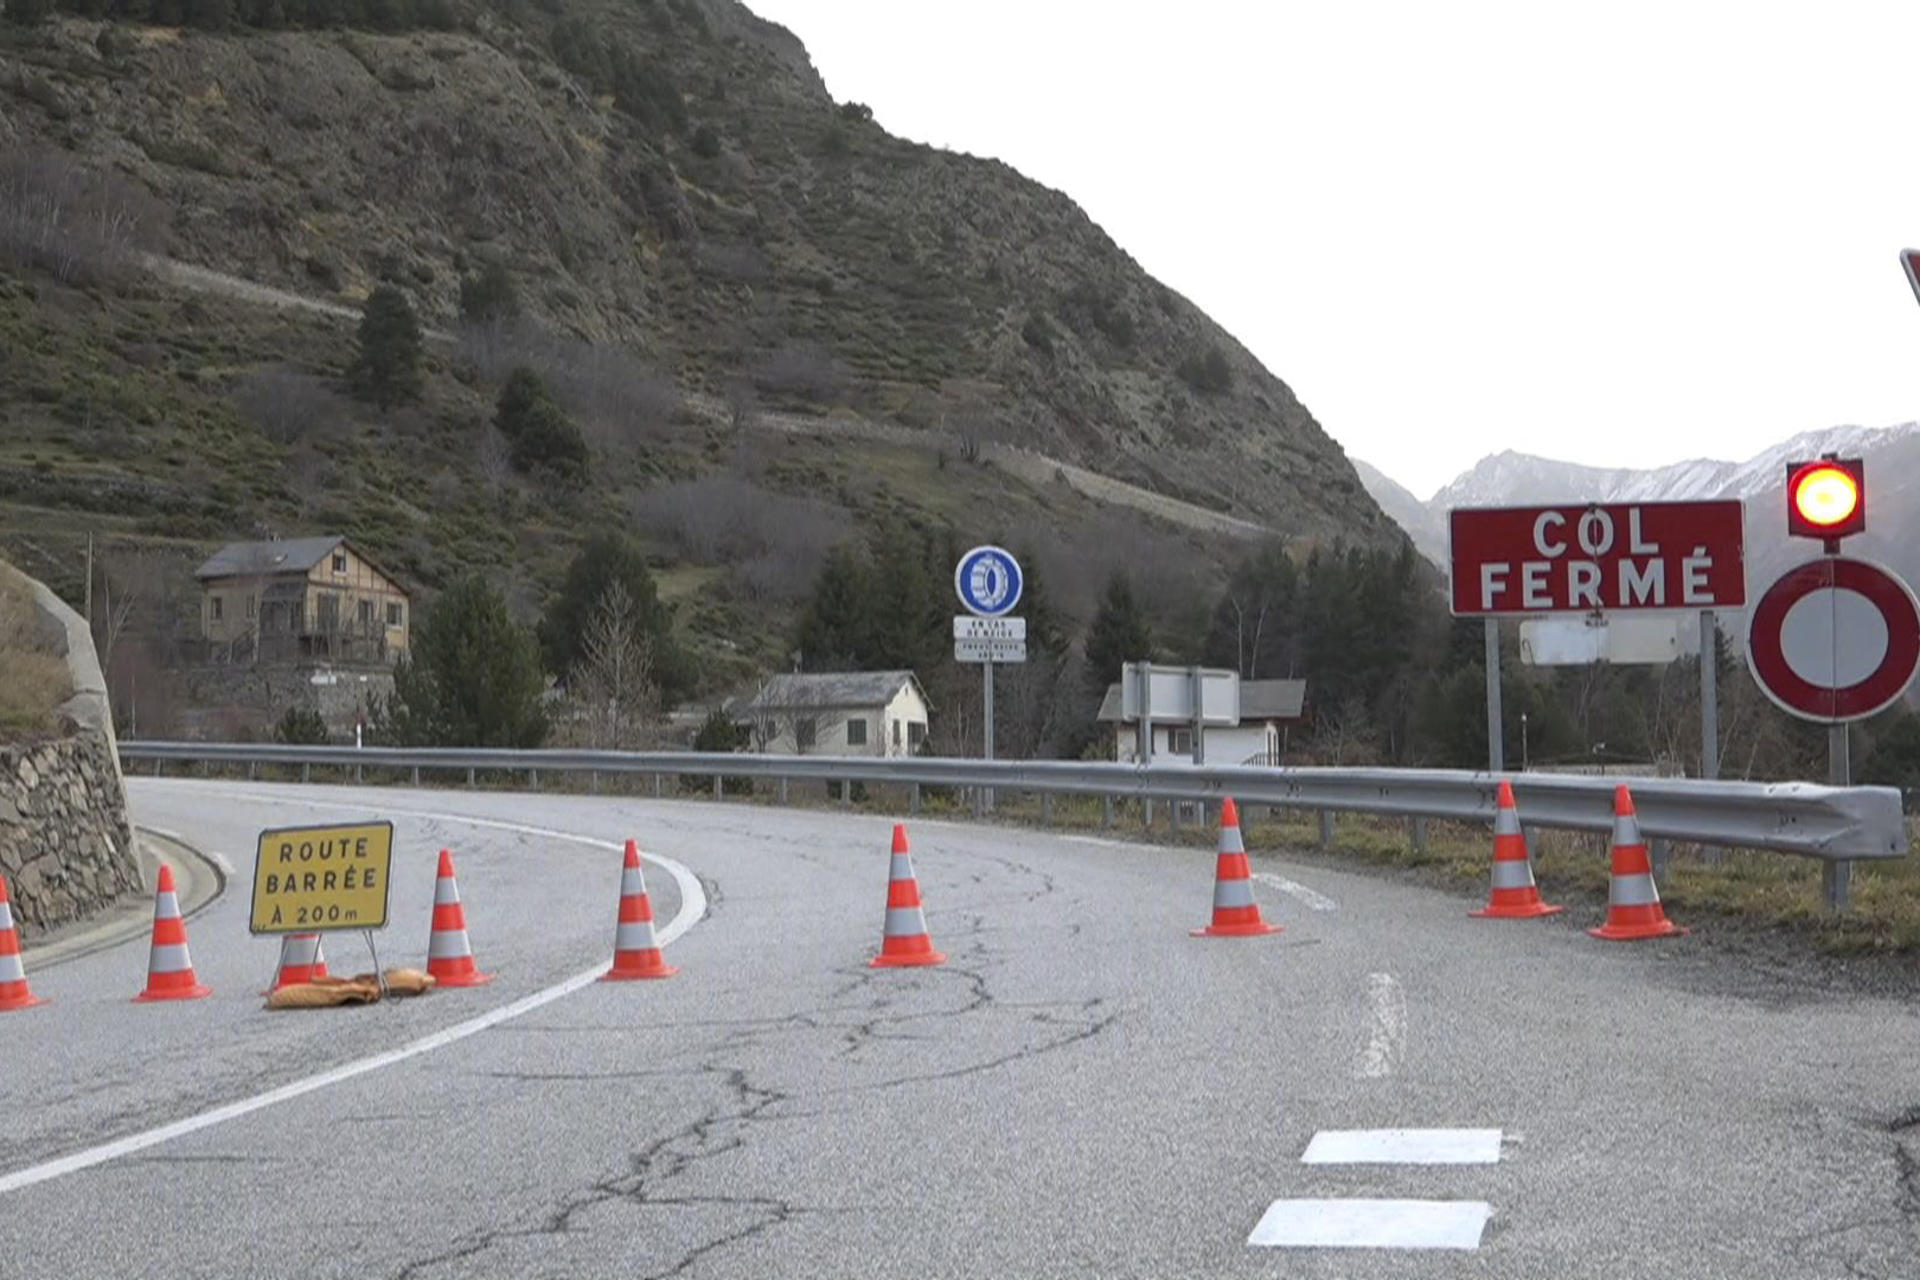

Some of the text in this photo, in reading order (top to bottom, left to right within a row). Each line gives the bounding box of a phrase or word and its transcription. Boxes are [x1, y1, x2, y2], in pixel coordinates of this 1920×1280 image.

[1533, 508, 1659, 557] COL
[1480, 546, 1715, 609] FERMÉ
[280, 837, 368, 863] ROUTE
[266, 864, 376, 894] BARRÉE
